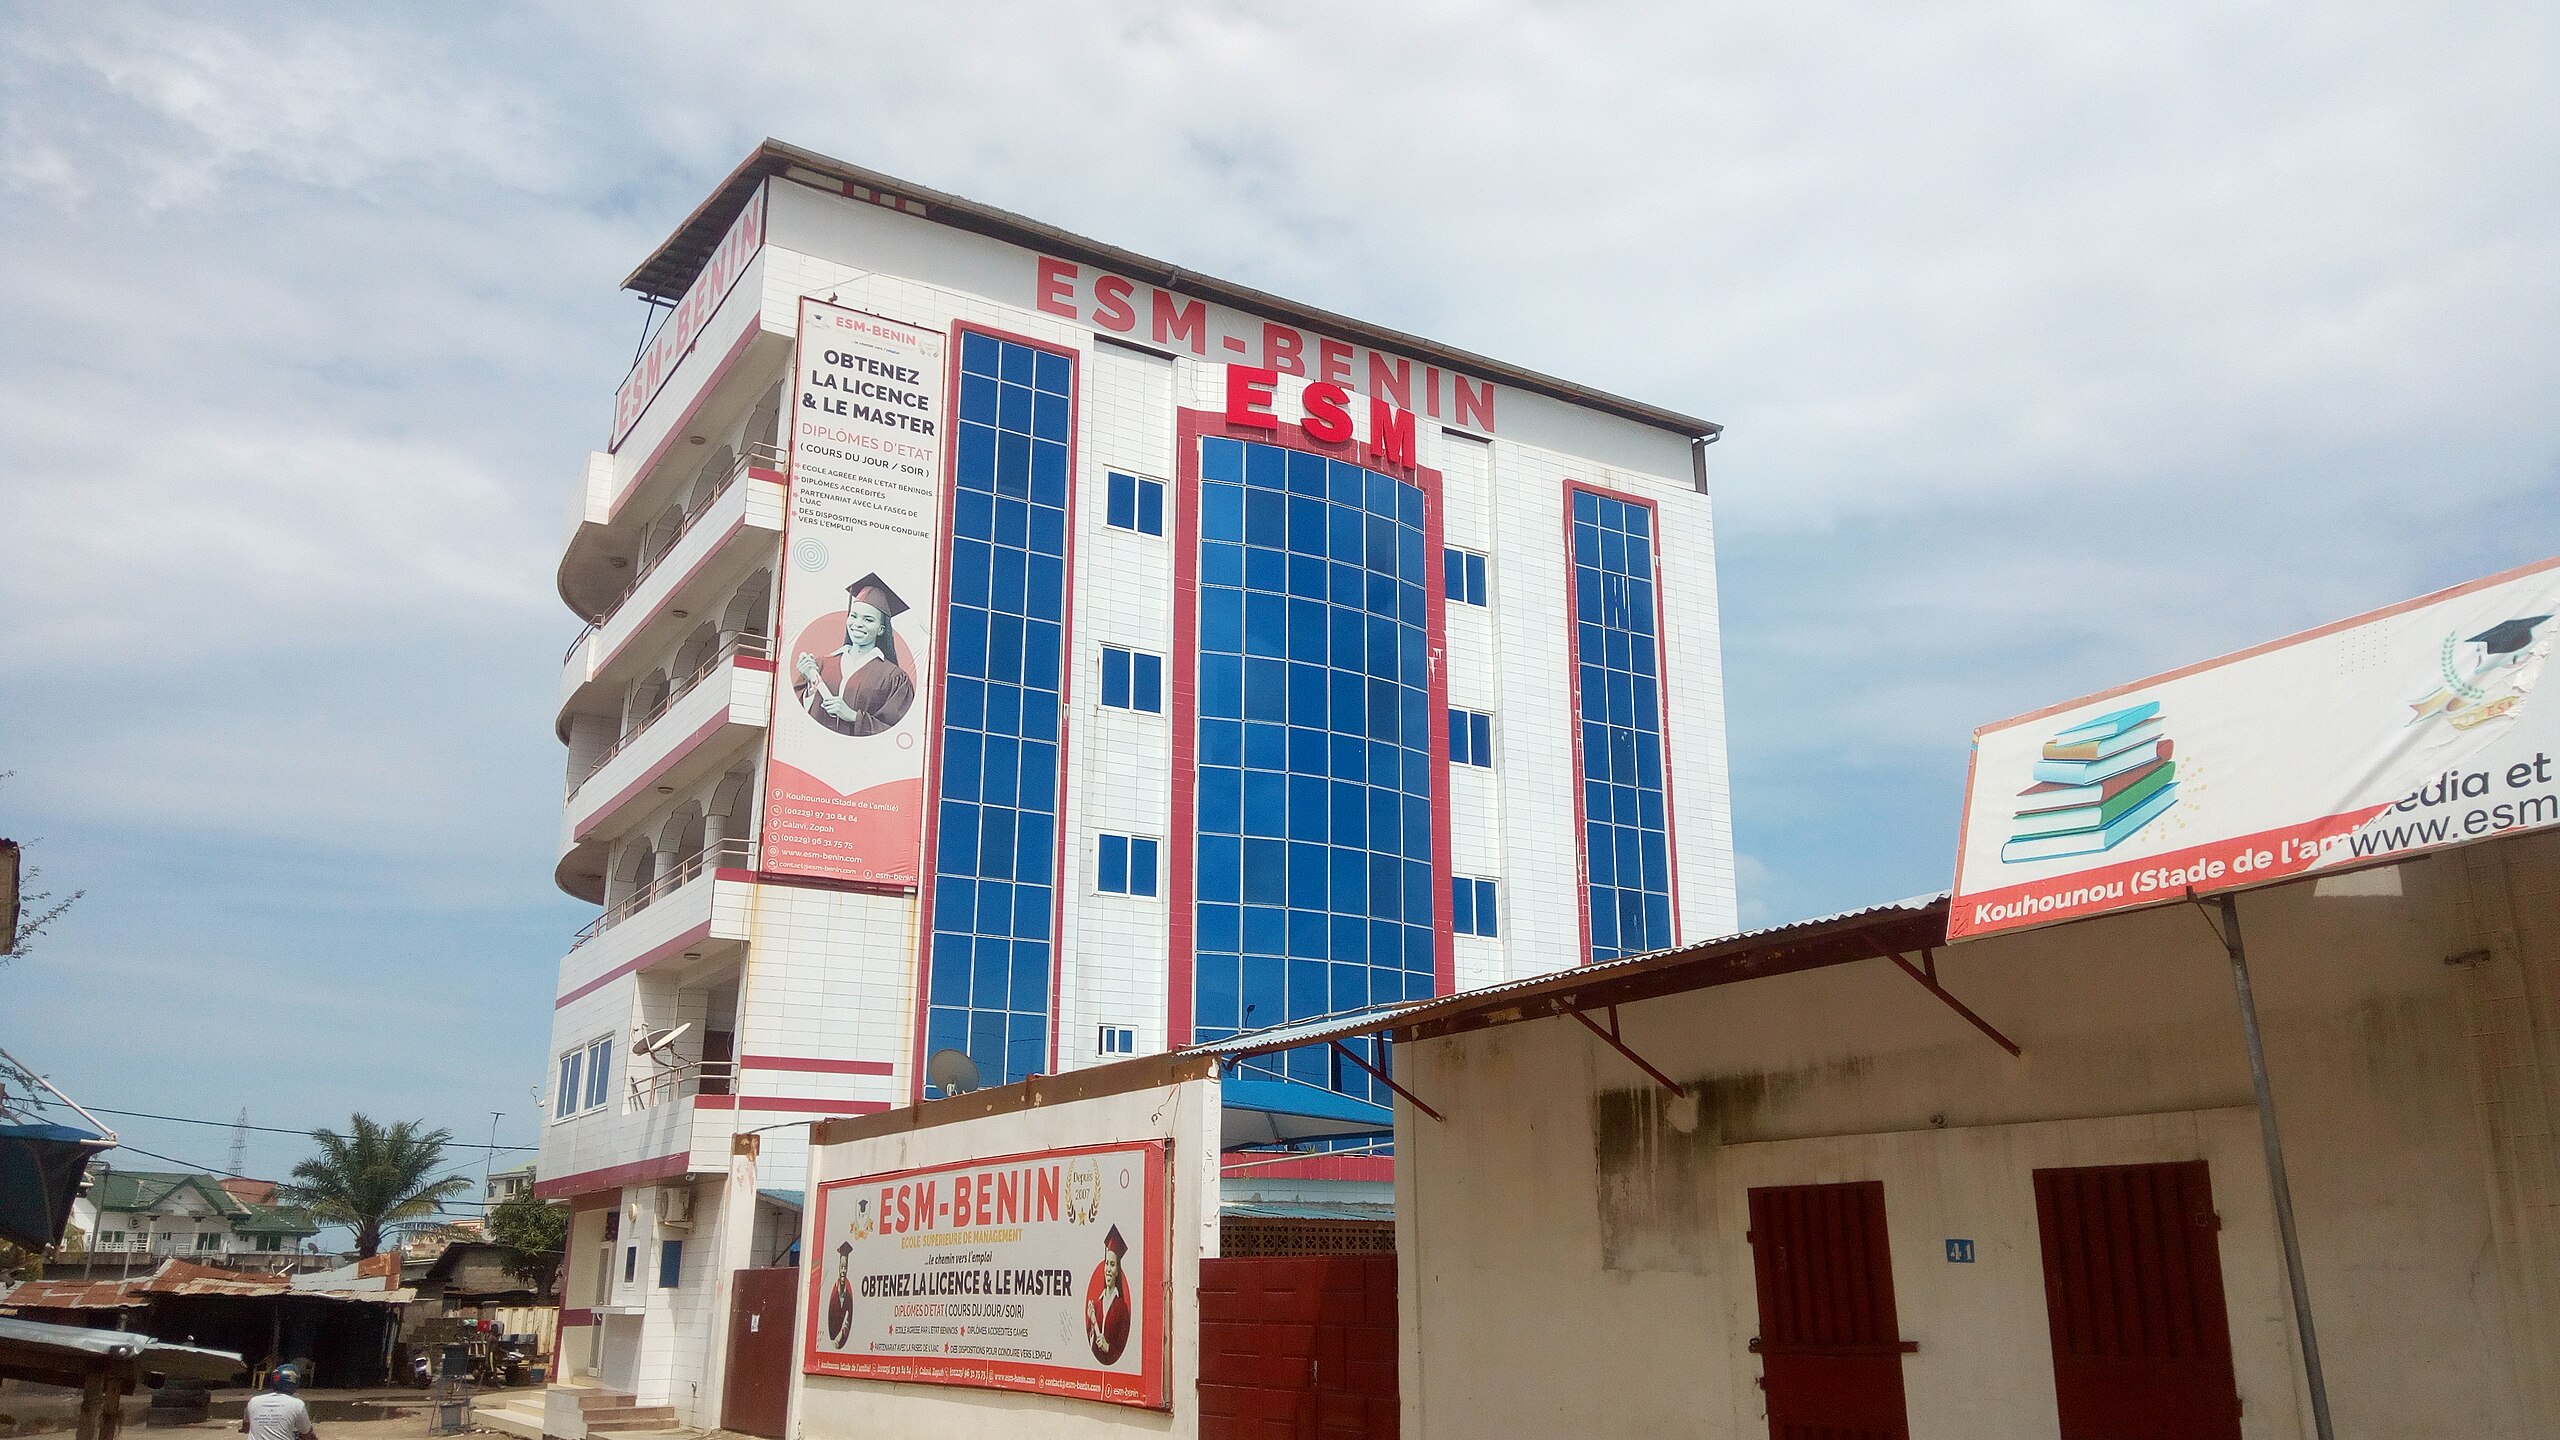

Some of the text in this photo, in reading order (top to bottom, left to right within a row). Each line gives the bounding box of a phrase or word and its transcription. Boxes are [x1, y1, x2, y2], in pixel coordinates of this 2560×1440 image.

[618, 196, 760, 435] ESM-BENIN
[835, 316, 916, 346] ESM-BENIN
[1036, 255, 1495, 433] ESM-BENIN
[823, 349, 920, 386] OBTENEZ
[811, 369, 929, 411] LA LICENCE
[802, 392, 935, 437] & LE MASTER
[1226, 362, 1416, 471] ESM
[802, 422, 933, 462] DIPLÔMES D'ETAT
[806, 444, 842, 459] COURS
[845, 452, 860, 462] DU
[862, 456, 889, 469] JOUR
[900, 465, 924, 477] SOIR
[858, 475, 874, 484] PAR
[800, 488, 851, 504] PARTENARIAT
[852, 500, 872, 508] AVEC
[873, 503, 882, 511] LA
[908, 510, 918, 518] DE
[798, 516, 854, 532] VERS L'EMPLOI
[799, 507, 930, 539] DES DISPOSITIONS POUR CONDUIRE
[2505, 752, 2552, 789] et
[784, 807, 814, 818] (00229)
[815, 811, 824, 819] 97
[837, 813, 847, 822] 84
[785, 791, 831, 804] Kouhounou
[858, 801, 868, 809] de
[809, 822, 834, 834] Zopah
[2350, 793, 2560, 858] www.esm
[781, 833, 811, 844] (00229)
[833, 840, 843, 848] 75
[844, 841, 853, 850] 75
[781, 849, 862, 863] www.esm-benin.com
[1974, 880, 2124, 925] Kouhounou
[2130, 858, 2225, 896] (Stade
[2232, 846, 2272, 874] de
[878, 1165, 1060, 1236] ESM-BENIN
[901, 1235, 920, 1249] ECOLE
[963, 1231, 972, 1244] DE
[973, 1228, 1023, 1243] MANAGEMENT
[1950, 1242, 1972, 1260] 41
[935, 1252, 955, 1265] chemin
[955, 1254, 967, 1264] vers
[861, 1269, 1072, 1298] OBTENEZ LA LICENCE & LE MASTER
[972, 1303, 982, 1317] DU
